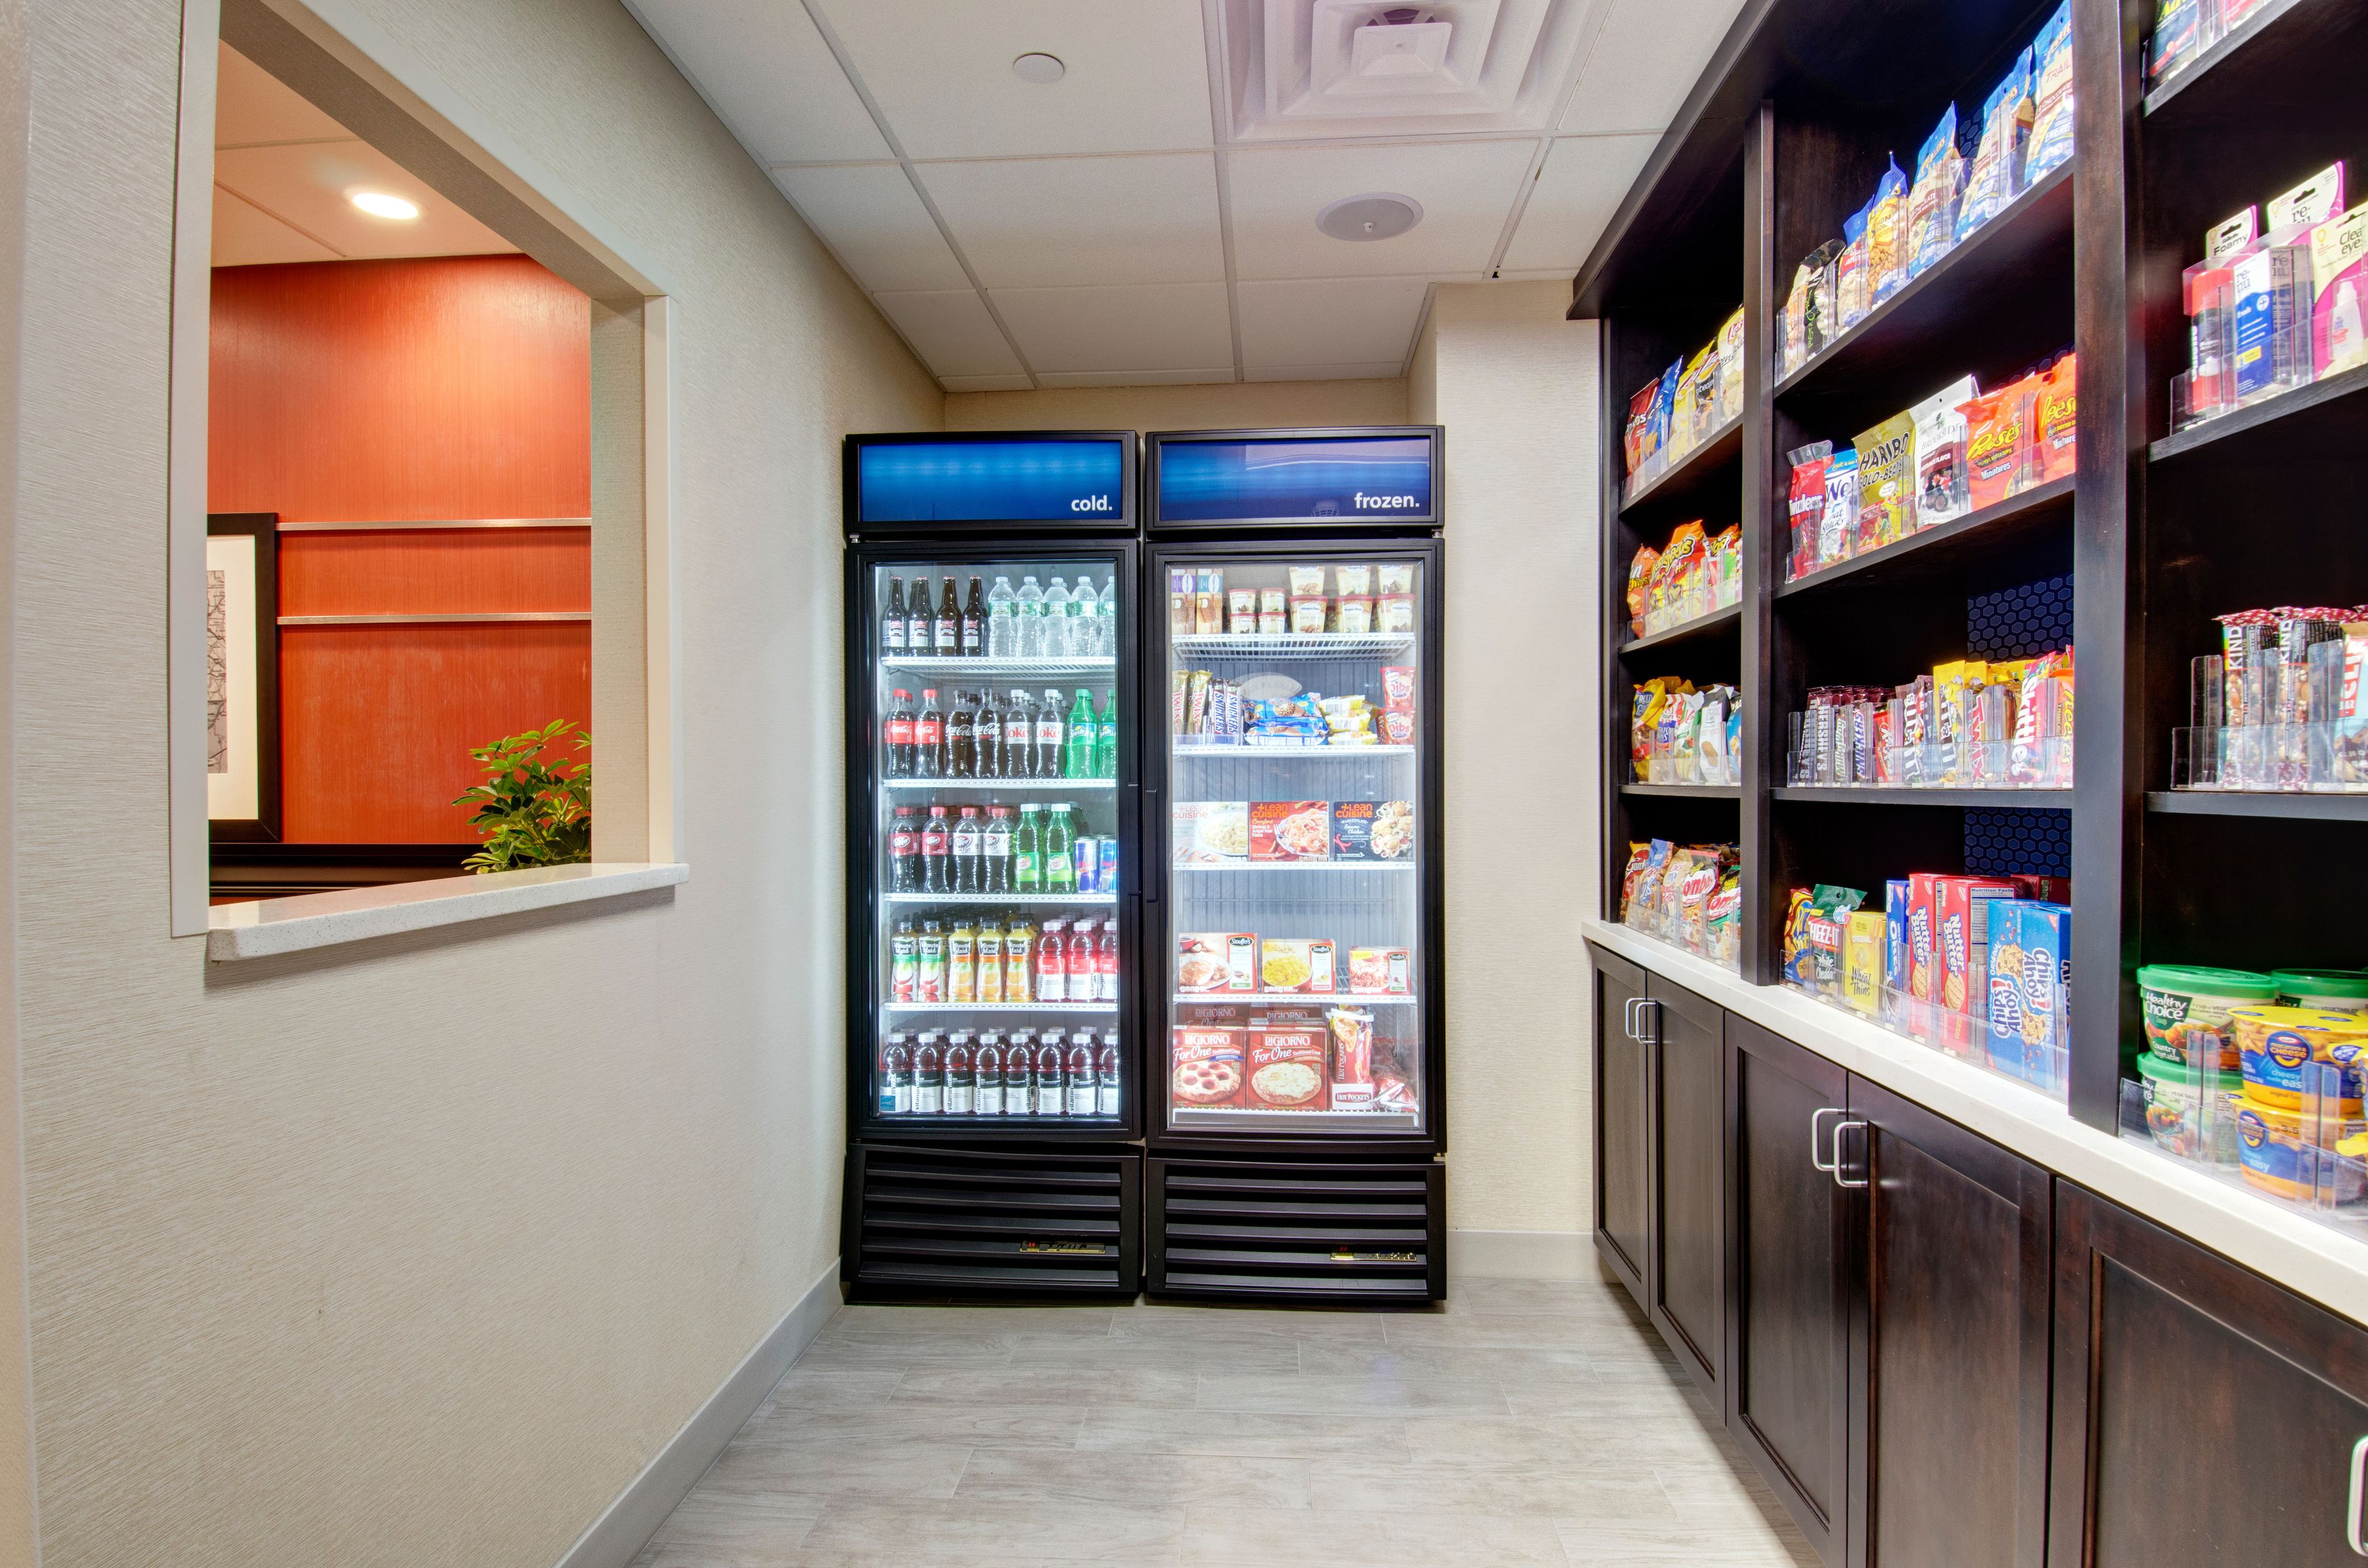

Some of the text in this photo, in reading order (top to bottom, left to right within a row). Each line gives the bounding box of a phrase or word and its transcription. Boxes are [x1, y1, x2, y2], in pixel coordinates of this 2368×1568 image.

[2045, 63, 2071, 83] TRAIL
[2045, 124, 2072, 143] ENERG
[2213, 234, 2248, 256] Foamy
[2341, 238, 2364, 255] eye
[1859, 432, 1910, 473] HARIBO
[1935, 451, 1951, 464] FLAVOR
[1858, 456, 1903, 490] GOLD-BEARS
[1825, 474, 1856, 503] Wel
[1071, 495, 1112, 511] cold.
[1354, 492, 1420, 509] frozen.
[2229, 626, 2243, 670] KIND
[2280, 620, 2293, 664] KIND
[1389, 681, 1410, 693] Dibs
[1172, 689, 1183, 720] TWIX
[1193, 691, 1204, 721] TWIX
[1215, 693, 1225, 733] SNICKERS
[1228, 695, 1238, 734] SNICKERS
[945, 724, 972, 736] Coca-Cola
[972, 723, 1000, 736] Coca-Cola
[1003, 726, 1029, 739] Coke
[1036, 726, 1060, 739] Coke
[1389, 722, 1410, 734] Dibs
[2011, 676, 2039, 777] Skittles
[1835, 718, 1847, 777] Milky Way
[1854, 710, 1866, 777] SNICKERS
[1971, 695, 1986, 782] TWIX
[1265, 803, 1288, 811] Lean
[1349, 803, 1373, 811] Lean
[1230, 937, 1252, 946] Stouffer's
[1809, 920, 1840, 946] HEEZ-IT
[1911, 914, 1925, 967] Butter
[1917, 907, 1931, 961] Nutter
[1889, 919, 1898, 976] OREO
[1944, 921, 1959, 977] Butter
[1950, 913, 1965, 972] Nutter
[1990, 941, 2002, 975] ORIGINAL
[1851, 965, 1871, 986] Wheat
[2033, 948, 2052, 998] Chips
[1850, 982, 1871, 997] Thins
[2145, 992, 2188, 1011] Healthy
[2145, 1001, 2184, 1020] Choice
[1195, 1008, 1236, 1017] DIGIORNO
[1993, 989, 2011, 1038] Chips
[2156, 1016, 2167, 1026] Soup
[1185, 1034, 1230, 1045] DIGIORNO
[1264, 1035, 1311, 1046] DIGIORNO
[2152, 1040, 2176, 1055] Country
[2271, 1043, 2302, 1051] macaroni
[1173, 1048, 1191, 1062] For
[1190, 1045, 1212, 1059] One
[1252, 1049, 1270, 1064] For
[1270, 1046, 1292, 1061] One
[2154, 1049, 2181, 1062] Vegetable
[1338, 1067, 1346, 1081] HOT
[2271, 1069, 2301, 1082] cheesy
[2281, 1078, 2303, 1089] eas
[1347, 1093, 1370, 1102] POCKETS
[2281, 1125, 2300, 1135] 3.5
[2249, 1158, 2270, 1173] easy
